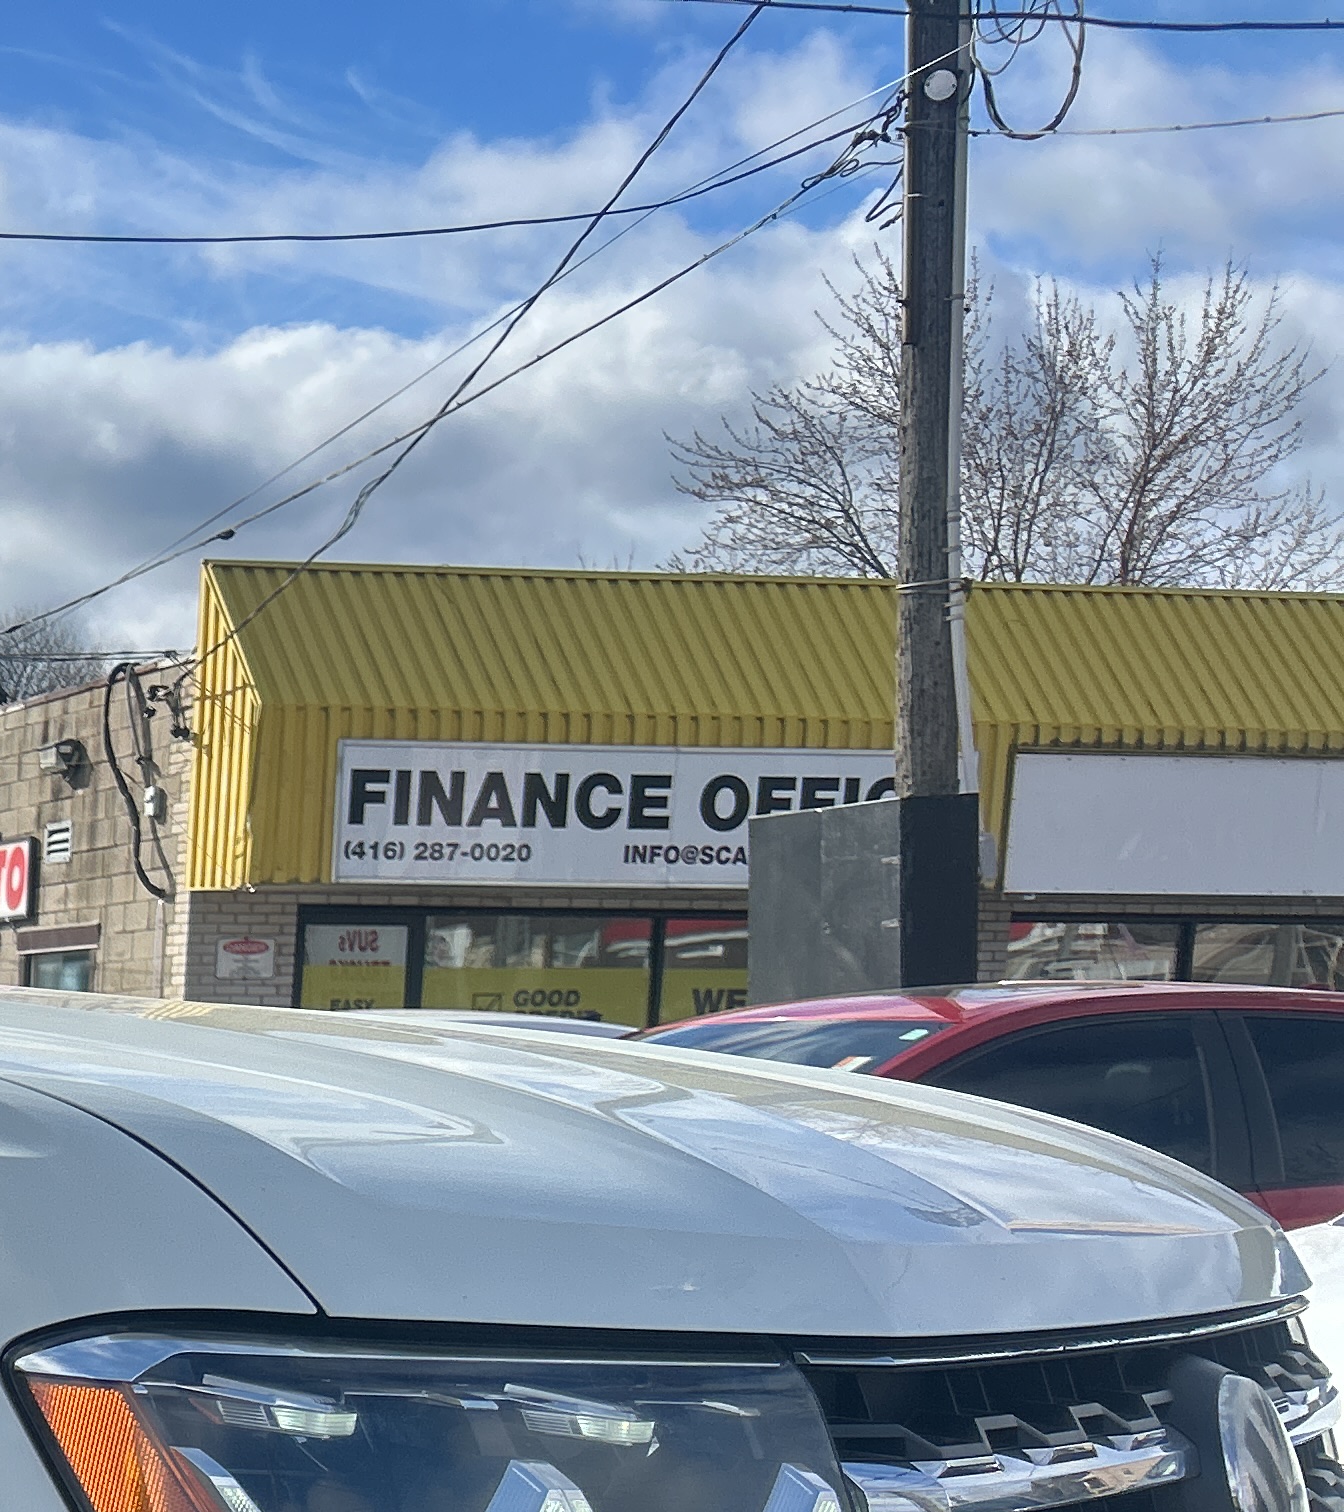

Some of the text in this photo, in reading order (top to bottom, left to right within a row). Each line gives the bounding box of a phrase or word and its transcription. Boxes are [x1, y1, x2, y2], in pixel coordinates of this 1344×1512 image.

[348, 768, 672, 831] FINANCE
[343, 840, 532, 862] (416) 287-0020
[623, 844, 748, 865] INFO@SCA
[513, 989, 581, 1008] GOOD
